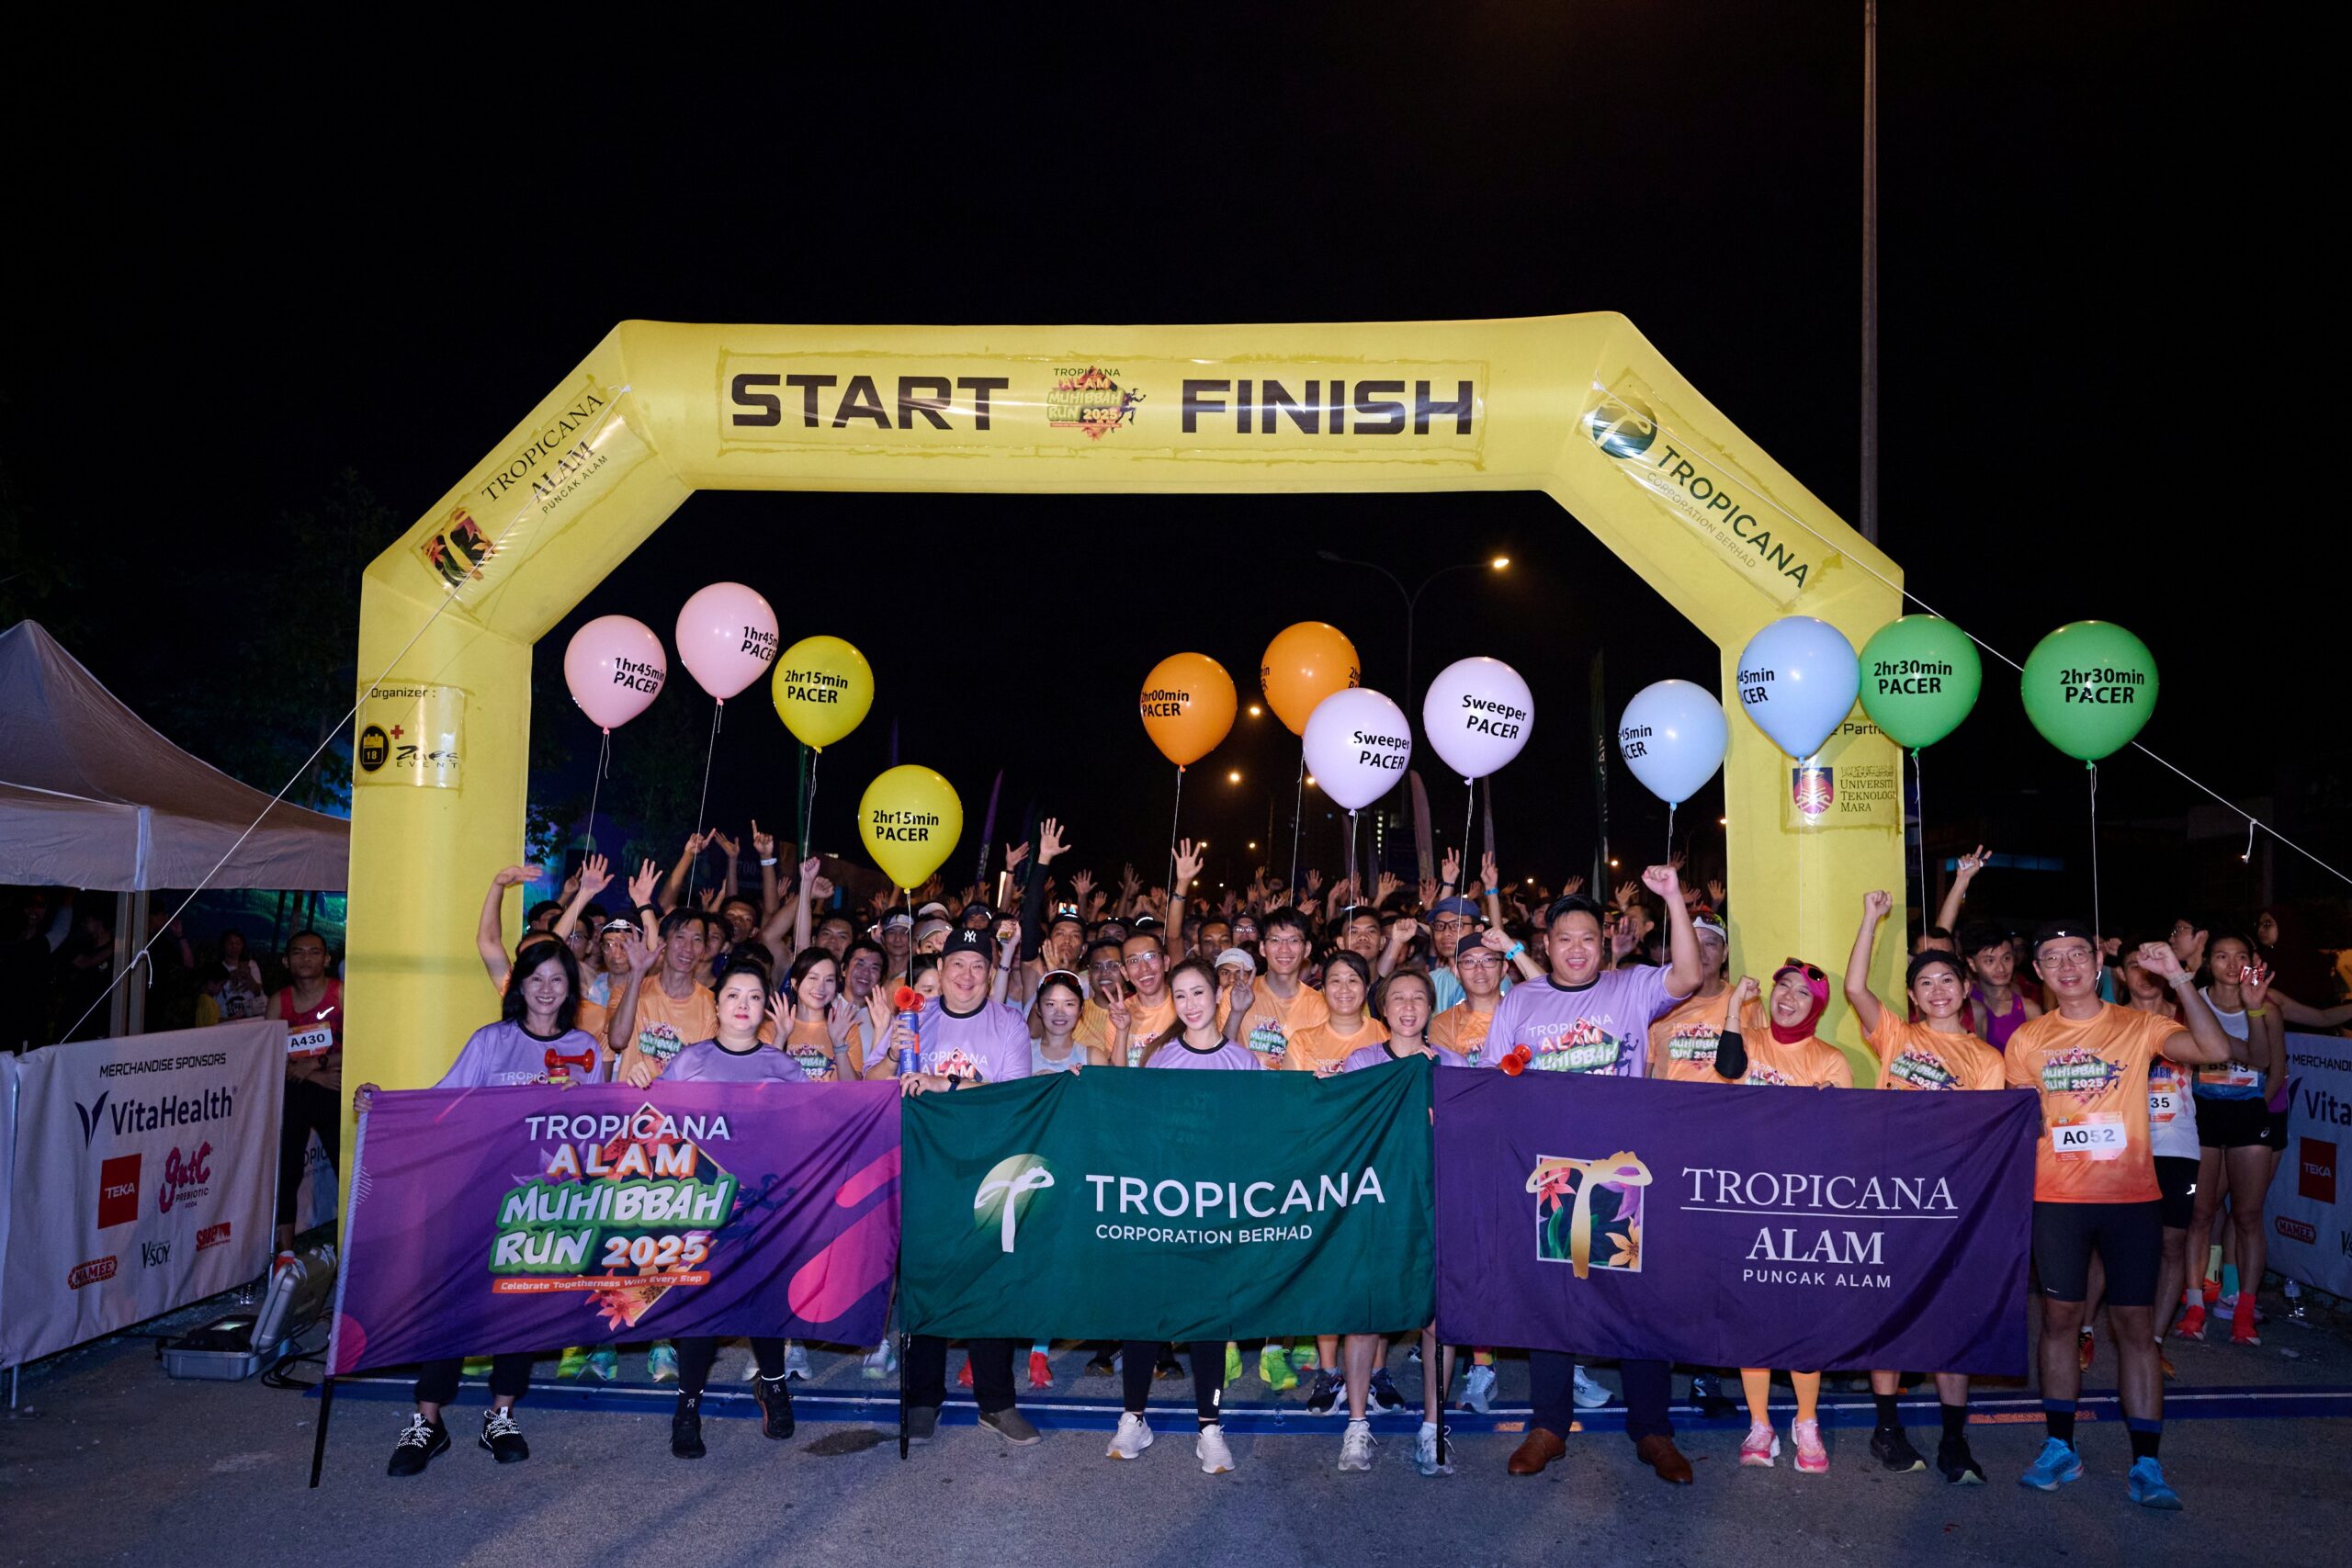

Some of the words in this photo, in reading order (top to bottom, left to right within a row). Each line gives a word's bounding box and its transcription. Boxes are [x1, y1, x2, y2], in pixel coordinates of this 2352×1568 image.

[1054, 367, 1121, 377] TROPICANA
[1060, 378, 1110, 389] ALAM
[731, 374, 1009, 430] START
[1048, 390, 1122, 404] MUHIBBAH
[1182, 379, 1473, 434] FINISH
[1048, 405, 1080, 419] RUN
[1083, 408, 1119, 420] 2025
[481, 395, 604, 502] TROPICANA
[531, 441, 595, 503] ALAM
[542, 480, 581, 513] PUNCAK
[582, 456, 608, 479] ALAM
[1647, 472, 1716, 534] CORPORATION
[1715, 531, 1756, 568] BERHAD
[1657, 445, 1809, 588] TROPICANA
[741, 640, 776, 662] PACER
[615, 657, 665, 682] 1hr45min
[1873, 660, 1952, 677] 2hr30min
[2060, 668, 2145, 685] 2hr30min
[613, 671, 658, 694] PACER
[784, 670, 849, 690] 2hr15min
[1878, 677, 1941, 694] PACER
[371, 687, 428, 699] Organizer
[787, 685, 838, 704] PACER
[1141, 689, 1190, 704] 2hr00min
[1741, 686, 1769, 705] CER
[2065, 686, 2135, 704] PACER
[1142, 703, 1182, 717] PACER
[1462, 694, 1527, 722] Sweeper
[1466, 715, 1520, 739] PACER
[1843, 723, 1886, 735] Partn
[1353, 730, 1410, 750] Sweeper
[367, 750, 377, 760] 18
[1359, 750, 1405, 770] PACER
[1622, 741, 1647, 761] ACER
[873, 810, 939, 826] 2hr15min
[876, 826, 929, 841] PACER
[290, 1033, 325, 1047] A430
[1250, 1041, 1269, 1050] RUN
[1541, 1028, 1601, 1051] ALAM
[99, 1058, 174, 1078] MERCHANDISE
[175, 1053, 226, 1069] SPONSORS
[2049, 1055, 2092, 1066] ALAM
[500, 1071, 548, 1083] TROPIC
[921, 1064, 974, 1078] ALAM
[2041, 1062, 2106, 1079] MUHIBBAH
[2043, 1078, 2067, 1089] RUN
[2071, 1077, 2104, 1089] 2025
[111, 1086, 232, 1136] VitaHealth
[2304, 1089, 2352, 1126] Vita
[525, 1114, 730, 1141] TROPICANA
[2063, 1128, 2116, 1145] A052
[548, 1143, 698, 1177] ALAM
[2303, 1162, 2332, 1177] TEKA
[105, 1182, 135, 1199] TEKA
[175, 1187, 209, 1202] PREBIOTIC
[1085, 1166, 1385, 1219] TROPICANA
[1682, 1167, 1959, 1210] TROPICANA
[503, 1179, 729, 1224] MUHIBBAH
[1095, 1224, 1232, 1244] CORPORATION
[1239, 1224, 1313, 1243] BERHAD
[2279, 1221, 2312, 1238] MAMEE
[142, 1241, 171, 1269] V-SOY
[494, 1228, 593, 1267] RUN
[601, 1235, 708, 1268] 2025
[1746, 1226, 1885, 1265] ALAM
[501, 1281, 549, 1290] Celebrate
[553, 1280, 620, 1289] Togetherness
[624, 1277, 647, 1286] With
[650, 1274, 676, 1285] Every
[680, 1274, 702, 1283] Step
[1743, 1269, 1826, 1285] PUNCAK
[1836, 1273, 1891, 1288] ALAM
